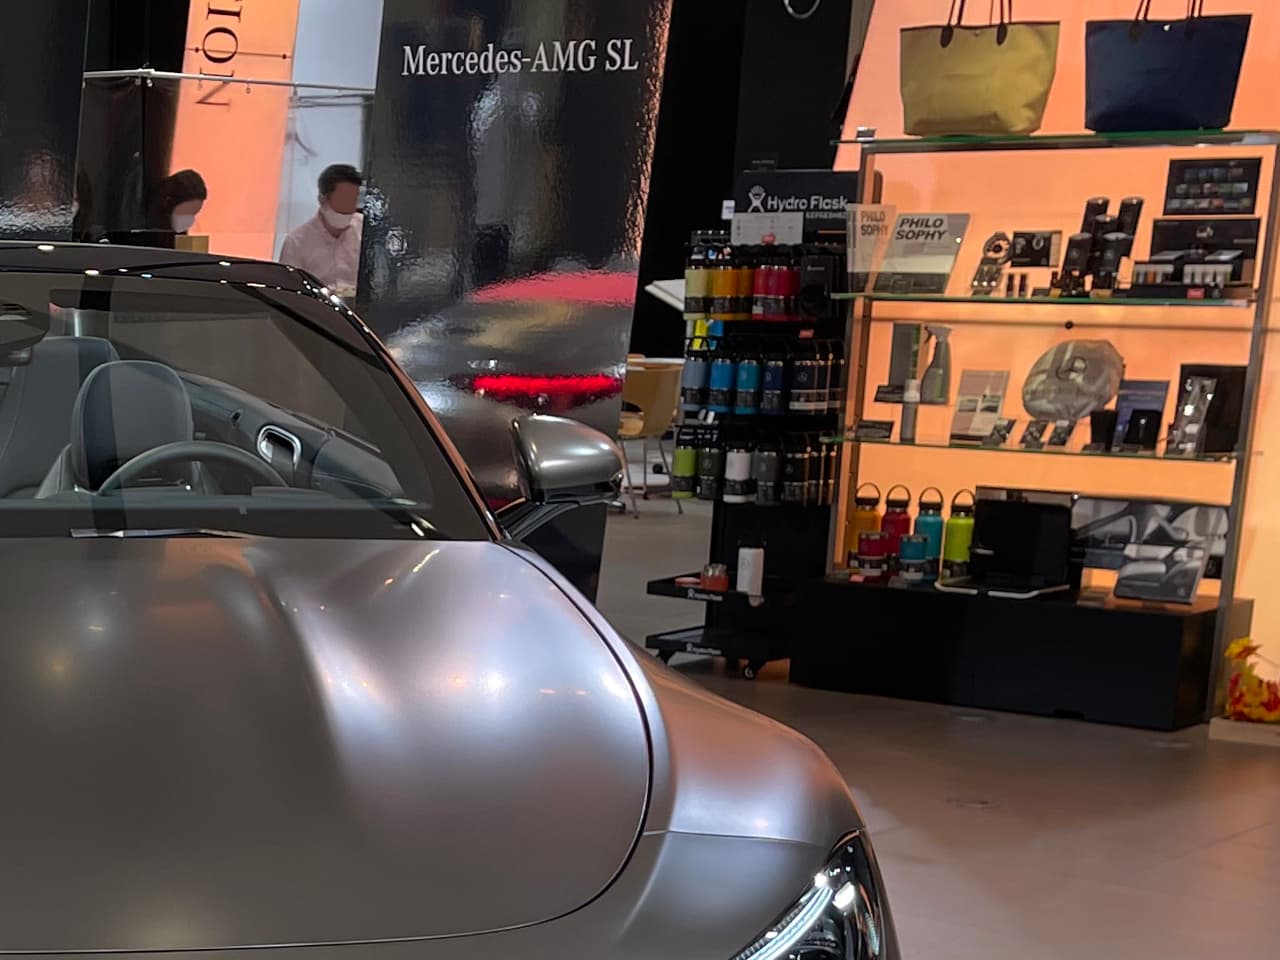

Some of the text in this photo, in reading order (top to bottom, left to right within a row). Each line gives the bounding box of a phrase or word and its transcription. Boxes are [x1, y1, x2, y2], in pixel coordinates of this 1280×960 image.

[402, 38, 639, 77] Mercedes-AMG SL
[767, 194, 849, 213] Hydro Flask
[860, 210, 886, 223] PHILO
[899, 218, 944, 228] PHILO
[860, 224, 889, 236] SOPHY
[895, 229, 947, 241] SOPHY
